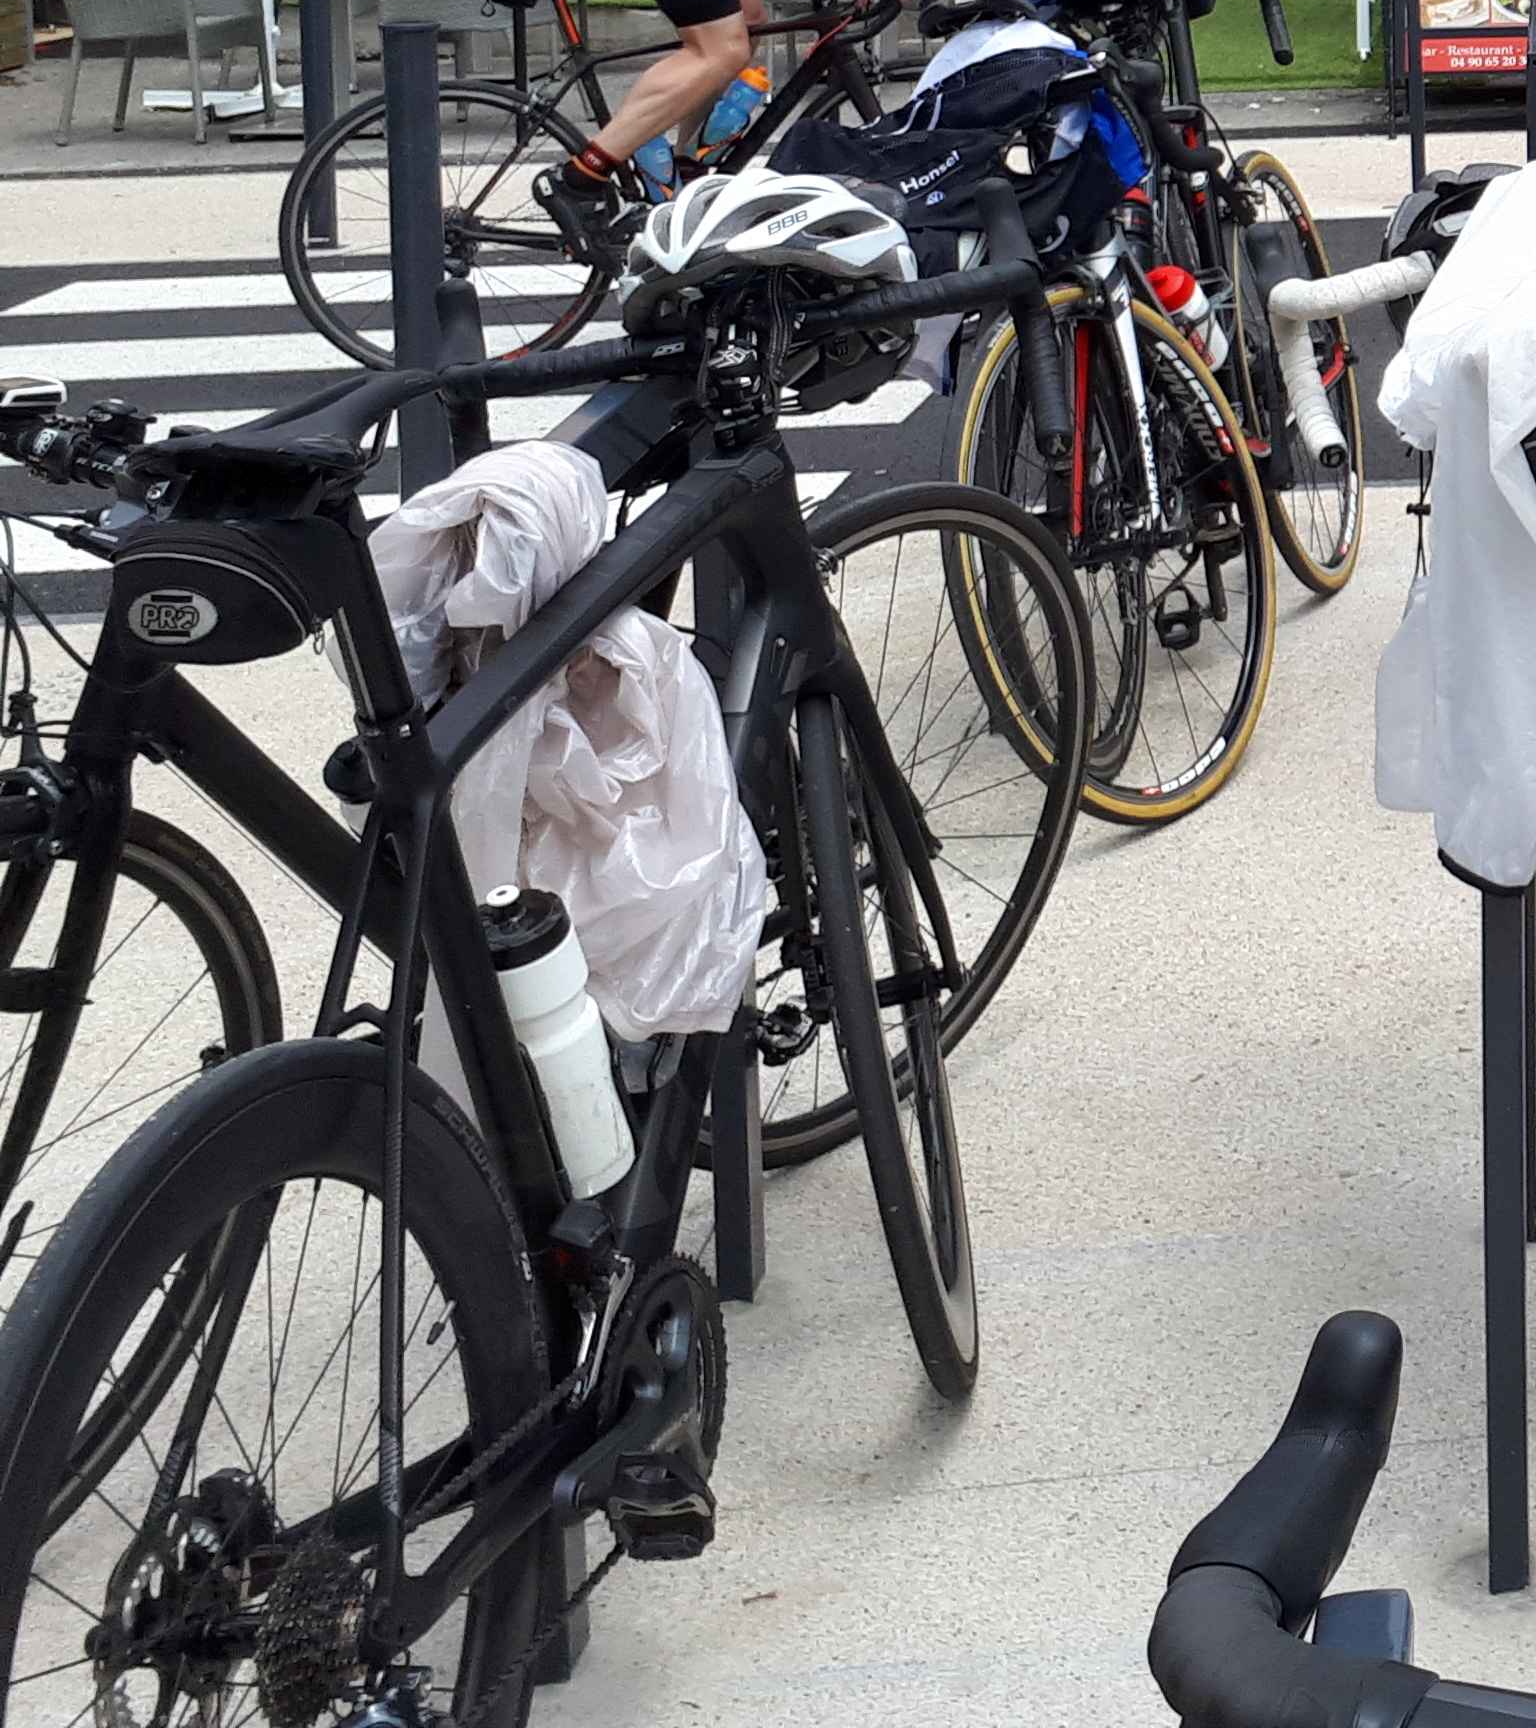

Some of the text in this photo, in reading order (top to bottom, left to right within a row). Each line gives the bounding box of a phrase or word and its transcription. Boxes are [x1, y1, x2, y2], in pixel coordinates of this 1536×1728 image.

[1448, 45, 1514, 56] Restaurant
[1451, 57, 1465, 66] 04
[1468, 57, 1483, 66] 90
[1503, 55, 1517, 65] 20
[766, 209, 809, 238] BBB
[140, 603, 200, 630] PRO
